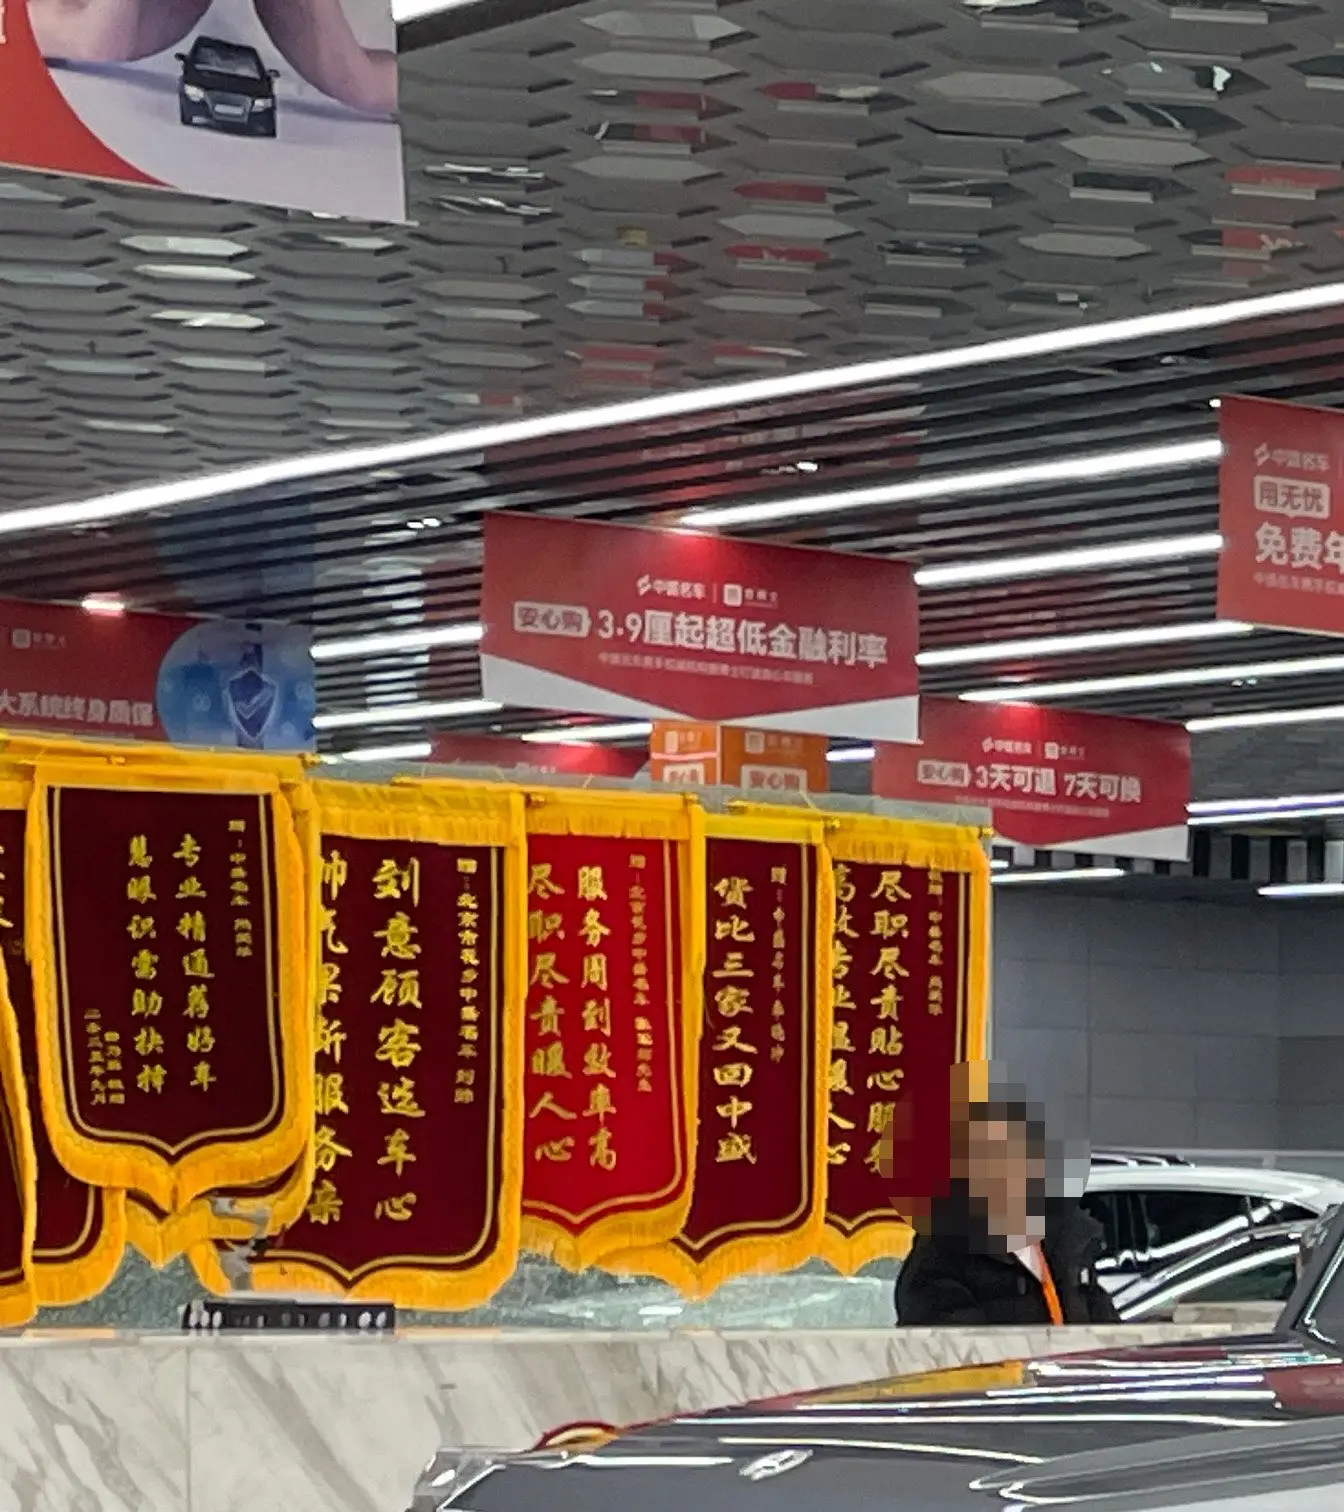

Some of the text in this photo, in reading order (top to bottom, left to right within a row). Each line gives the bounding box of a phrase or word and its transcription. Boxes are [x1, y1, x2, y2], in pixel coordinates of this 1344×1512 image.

[1260, 482, 1324, 512] 用无忧
[518, 606, 584, 633] 安心购
[976, 763, 1056, 796] 3天可退
